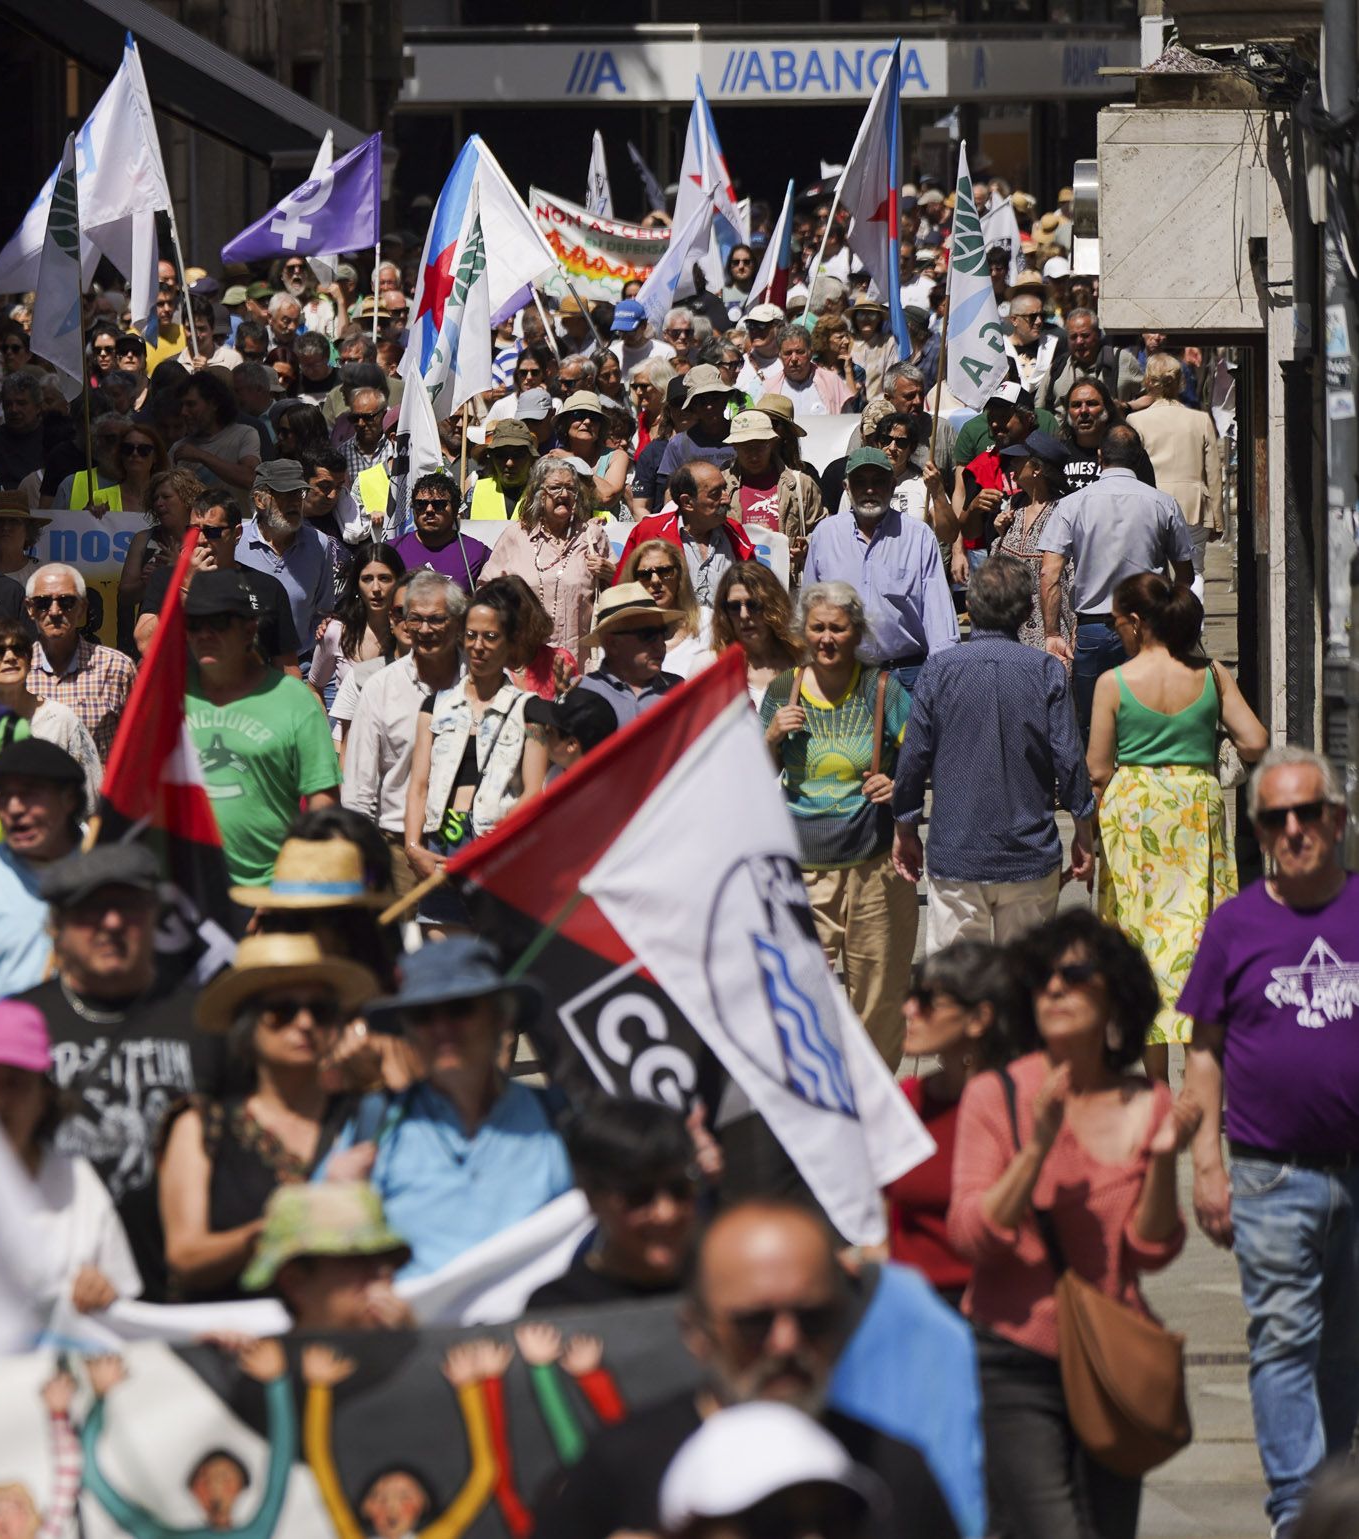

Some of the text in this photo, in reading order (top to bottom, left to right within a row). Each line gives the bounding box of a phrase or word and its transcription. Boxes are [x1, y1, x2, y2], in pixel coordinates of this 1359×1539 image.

[535, 203, 582, 230] NON
[1062, 461, 1096, 476] AMES
[184, 708, 273, 746] NCOUVER
